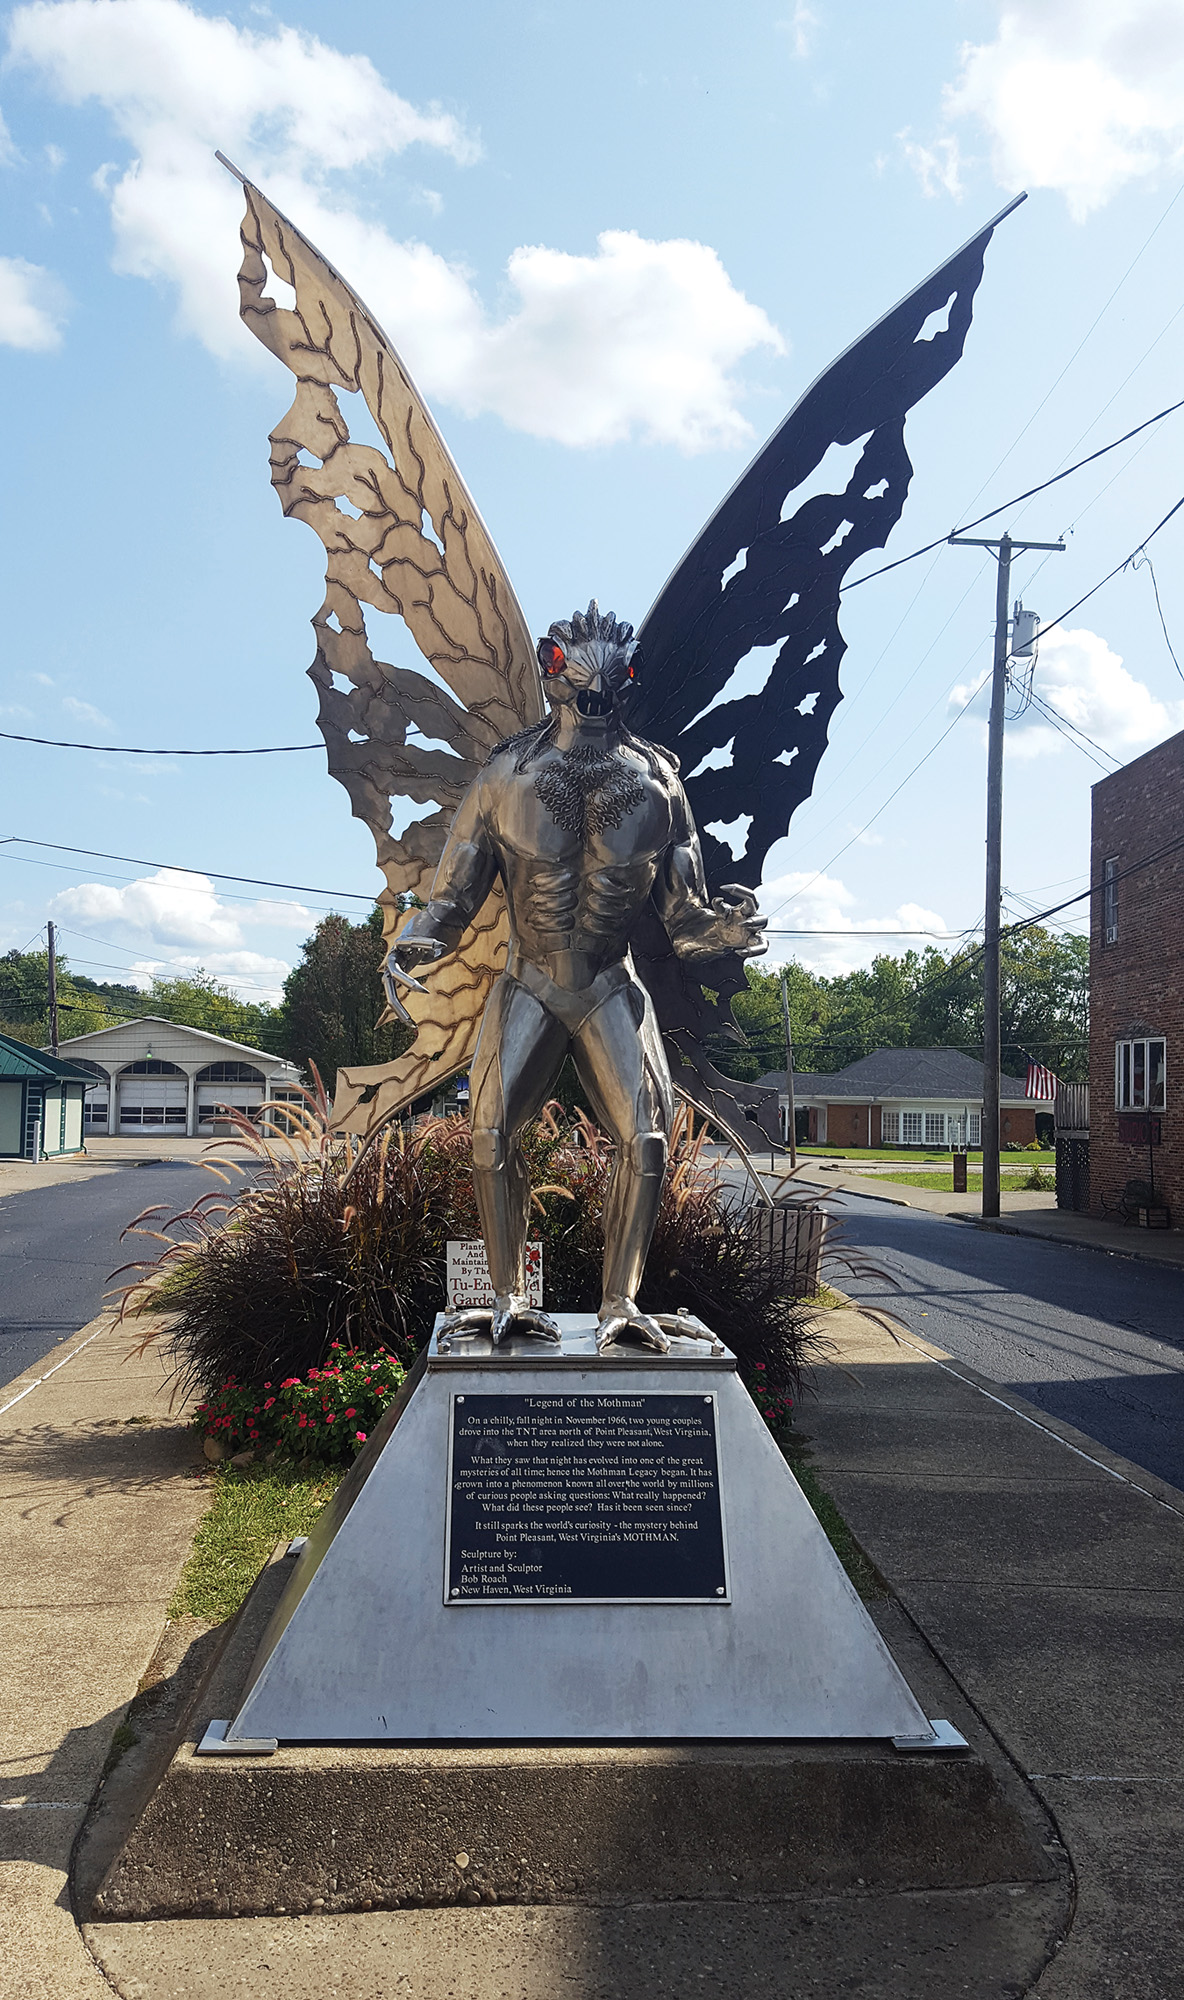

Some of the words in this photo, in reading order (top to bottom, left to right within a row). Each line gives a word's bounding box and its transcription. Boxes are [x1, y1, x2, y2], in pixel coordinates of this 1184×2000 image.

[460, 1242, 486, 1250] Plante
[467, 1250, 484, 1258] And
[461, 1267, 472, 1276] By
[453, 1292, 493, 1306] Garde
[524, 1398, 564, 1410] "Legend
[566, 1397, 578, 1407] of
[580, 1398, 595, 1407] the
[597, 1398, 645, 1408] Mothman"
[467, 1416, 481, 1425] On
[490, 1416, 515, 1426] chilly,
[516, 1416, 530, 1424] fall
[531, 1416, 553, 1426] night
[554, 1416, 563, 1424] in
[565, 1416, 606, 1425] November
[607, 1416, 628, 1425] 1966,
[628, 1417, 645, 1425] two
[646, 1418, 671, 1426] young
[672, 1417, 702, 1427] couples
[458, 1427, 482, 1436] drove
[483, 1427, 500, 1436] into
[501, 1427, 514, 1436] the
[516, 1427, 538, 1436] TNT
[559, 1427, 581, 1436] north
[583, 1427, 593, 1436] of
[595, 1427, 616, 1436] Point
[617, 1427, 653, 1437] Pleasant,
[653, 1427, 673, 1436] West
[674, 1428, 712, 1438] Virginia,
[506, 1438, 529, 1447] when
[531, 1438, 549, 1449] they
[551, 1438, 585, 1447] realized
[587, 1438, 605, 1449] they
[641, 1439, 665, 1447] alone.
[471, 1456, 493, 1464] What
[494, 1456, 513, 1466] they
[532, 1456, 549, 1464] that
[550, 1456, 572, 1467] night
[573, 1456, 588, 1464] has
[588, 1456, 619, 1465] evolved
[621, 1456, 638, 1464] into
[655, 1456, 665, 1465] of
[667, 1456, 680, 1465] the
[681, 1458, 704, 1467] great
[460, 1467, 499, 1479] mysteries
[500, 1467, 510, 1476] of
[511, 1468, 522, 1476] all
[546, 1467, 570, 1476] hence
[572, 1467, 585, 1476] the
[587, 1467, 626, 1476] Mothman
[628, 1468, 658, 1478] Legacy
[661, 1468, 688, 1479] began.
[690, 1468, 697, 1476] It
[698, 1468, 713, 1476] has
[457, 1481, 483, 1490] grown
[486, 1479, 503, 1488] into
[512, 1479, 563, 1490] phenomenon
[565, 1479, 594, 1488] known
[596, 1479, 607, 1488] all
[627, 1479, 640, 1488] the
[642, 1479, 665, 1488] world
[667, 1479, 678, 1490] by
[679, 1479, 714, 1488] millions
[465, 1491, 476, 1500] of
[477, 1491, 508, 1500] curious
[510, 1491, 537, 1502] people
[538, 1490, 567, 1502] asking
[568, 1490, 610, 1502] questions:
[611, 1490, 634, 1499] What
[635, 1491, 660, 1502] really
[662, 1491, 706, 1502] happened?
[482, 1503, 505, 1512] What
[506, 1503, 520, 1512] did
[522, 1503, 544, 1512] these
[546, 1503, 573, 1514] people
[574, 1502, 593, 1512] see?
[597, 1503, 614, 1512] Has
[615, 1502, 621, 1511] it
[622, 1503, 643, 1512] been
[666, 1503, 692, 1512] since?
[475, 1521, 482, 1530] It
[483, 1521, 500, 1530] still
[501, 1521, 529, 1532] sparks
[530, 1521, 543, 1530] the
[545, 1520, 574, 1530] world's
[574, 1520, 612, 1531] curiosity
[619, 1520, 632, 1529] the
[634, 1522, 668, 1531] mystery
[669, 1520, 699, 1530] behind
[496, 1533, 517, 1542] Point
[520, 1533, 557, 1542] Pleasant,
[558, 1533, 578, 1542] West
[580, 1532, 621, 1544] Virginia's
[623, 1532, 679, 1542] MOTHMAN.
[461, 1549, 502, 1561] Sculpture
[503, 1549, 517, 1560] by:
[461, 1563, 488, 1573] Artist
[489, 1563, 505, 1573] and
[507, 1563, 543, 1574] Sculptor
[461, 1574, 479, 1583] Bob
[481, 1574, 507, 1583] Roach
[461, 1585, 481, 1594] New
[482, 1585, 512, 1594] Haven,
[512, 1585, 533, 1594] West
[535, 1584, 572, 1596] Virginia
